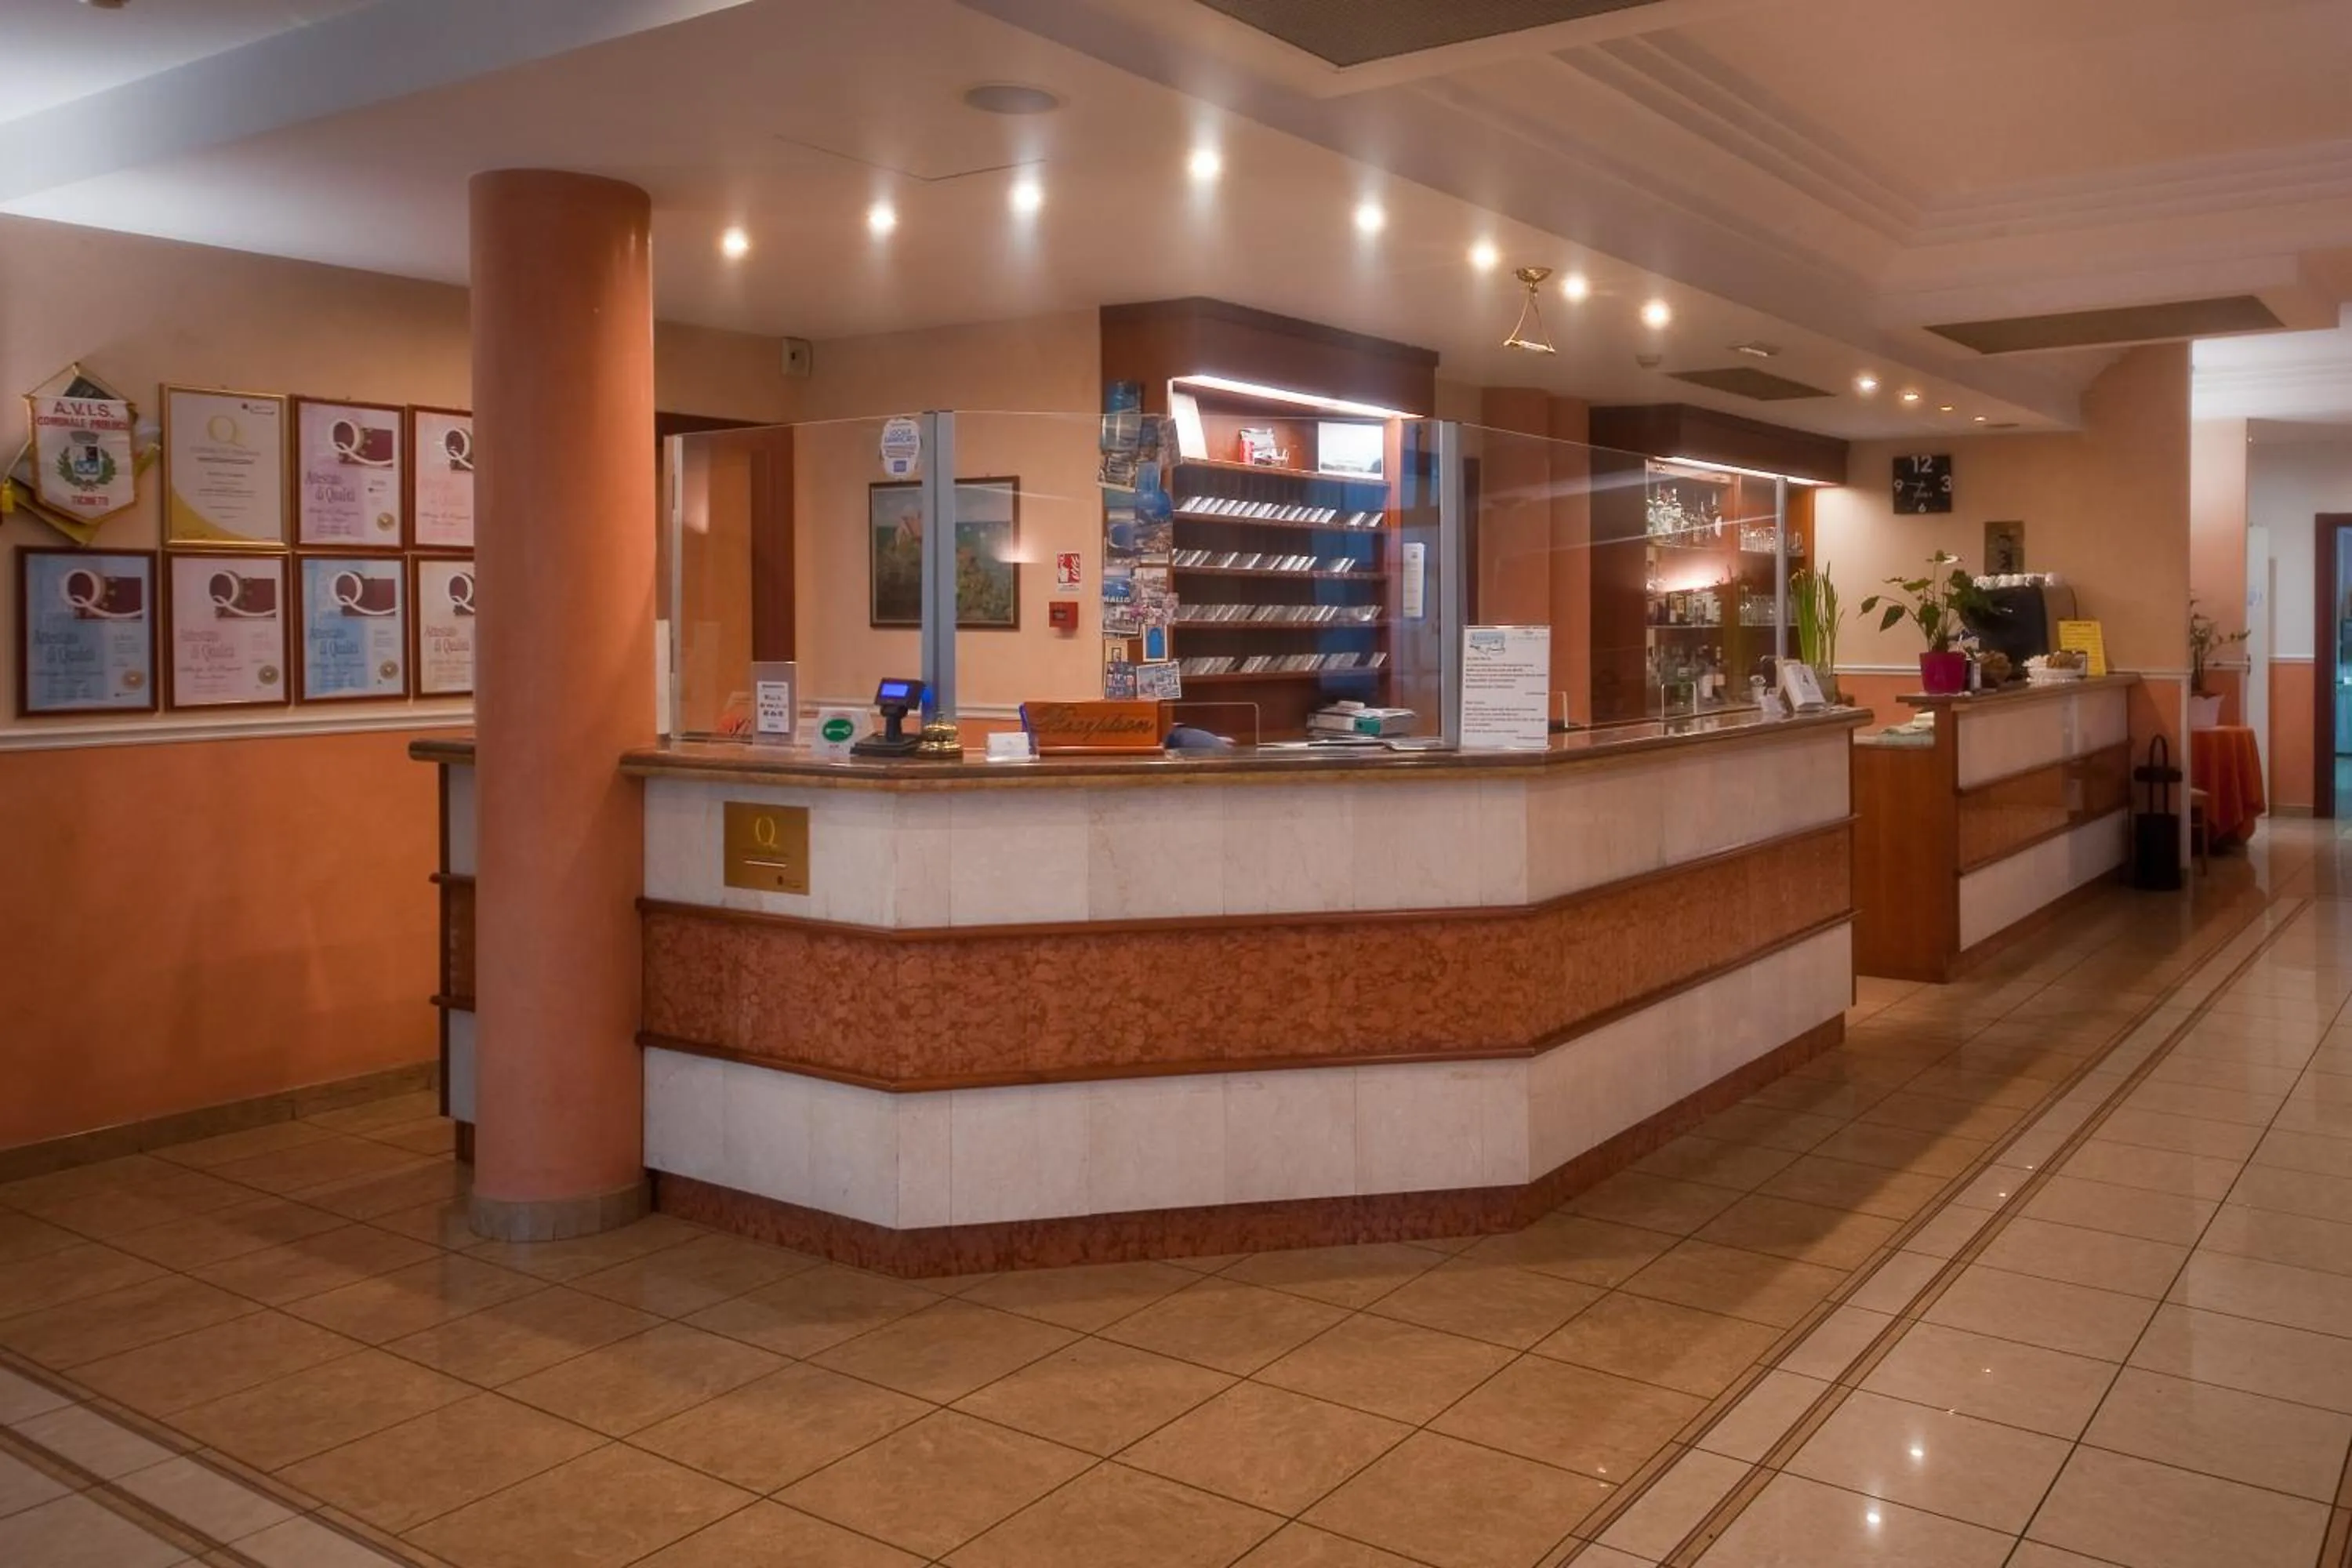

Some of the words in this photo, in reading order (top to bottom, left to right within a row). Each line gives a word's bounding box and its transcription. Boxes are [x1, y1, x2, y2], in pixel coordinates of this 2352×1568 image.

[53, 401, 114, 418] A.V.I.S.
[329, 419, 393, 466] Q
[1911, 455, 1933, 473] 12
[1893, 479, 1904, 492] 9
[1940, 475, 1952, 492] 3
[1918, 503, 1926, 513] 6
[60, 568, 144, 619] Q
[208, 571, 276, 616] Q
[330, 571, 396, 615] Q
[447, 572, 475, 612] Q
[755, 815, 778, 848] Q
